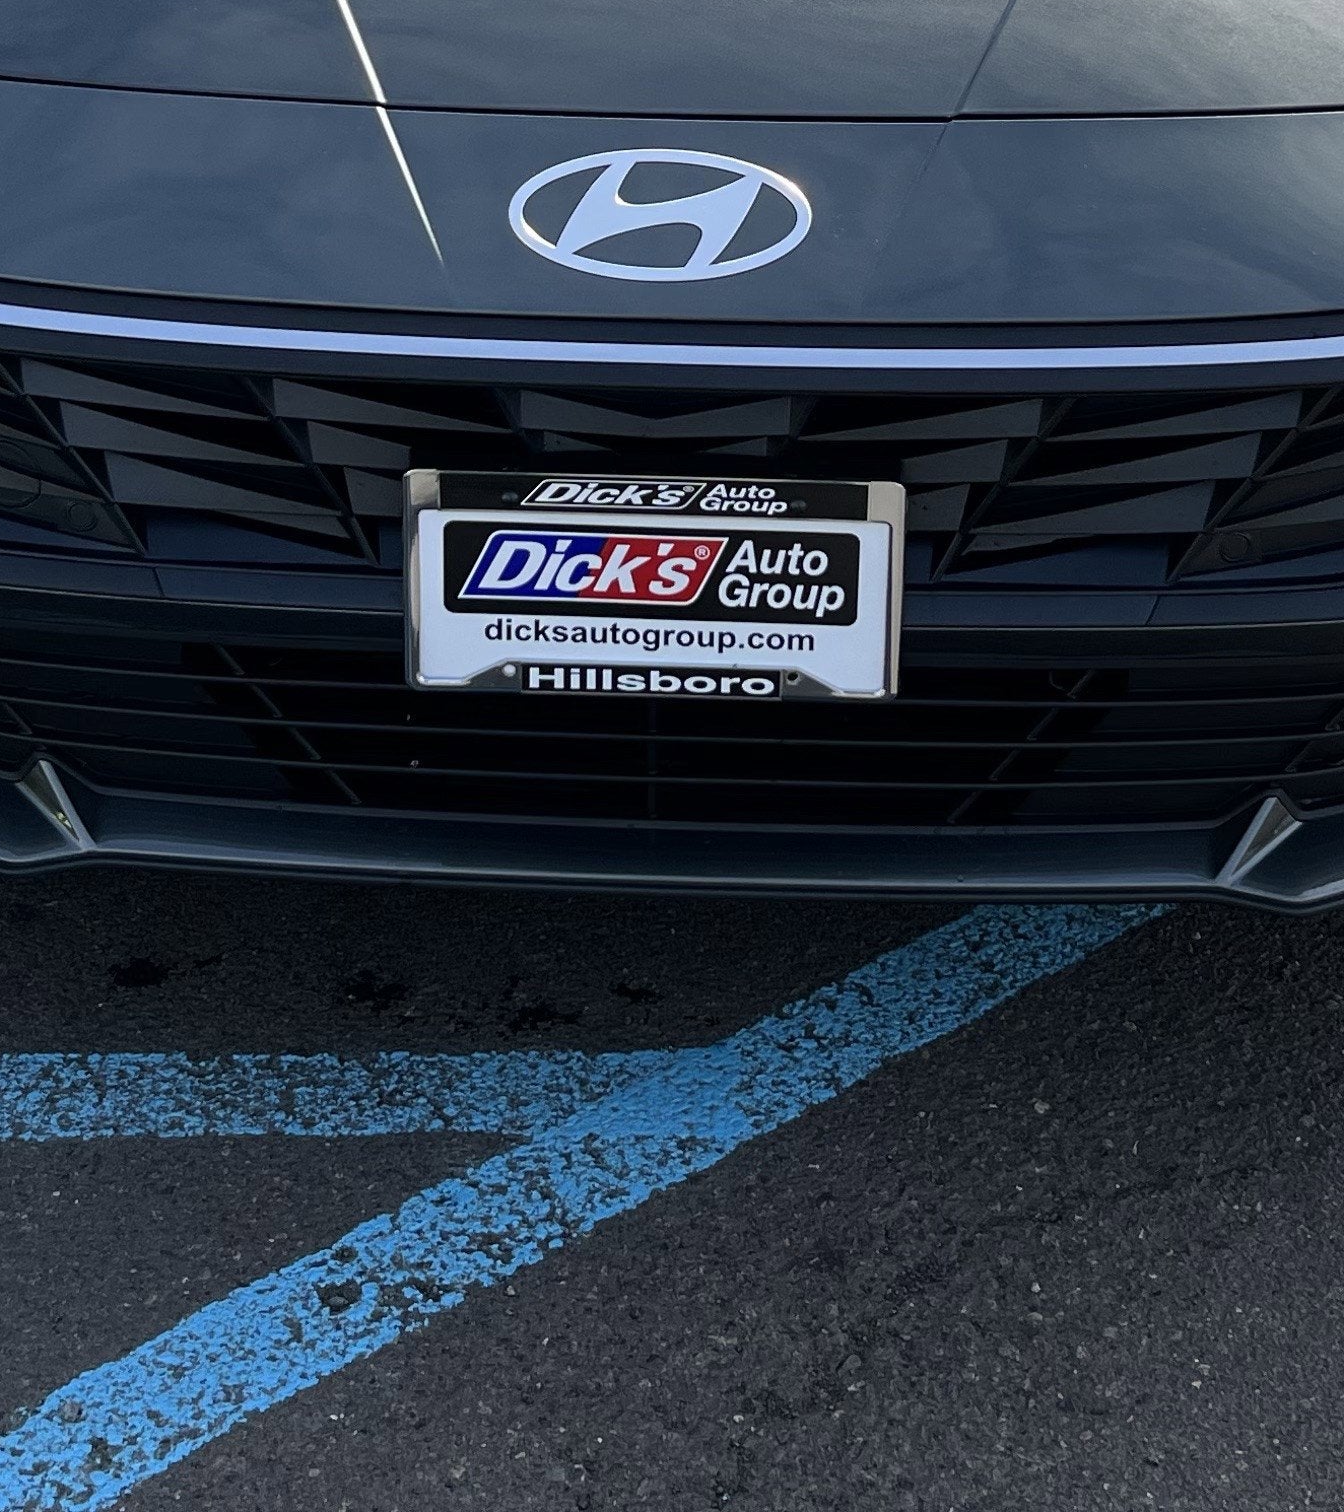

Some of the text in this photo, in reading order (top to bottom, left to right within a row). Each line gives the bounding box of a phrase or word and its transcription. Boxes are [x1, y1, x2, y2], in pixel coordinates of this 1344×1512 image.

[534, 482, 775, 506] Dick's Auto
[699, 497, 788, 516] Group
[476, 539, 829, 597] Dick's Auto
[718, 573, 846, 618] Group
[483, 618, 816, 654] dicksautogroup.com
[528, 666, 776, 696] Hillsboro
